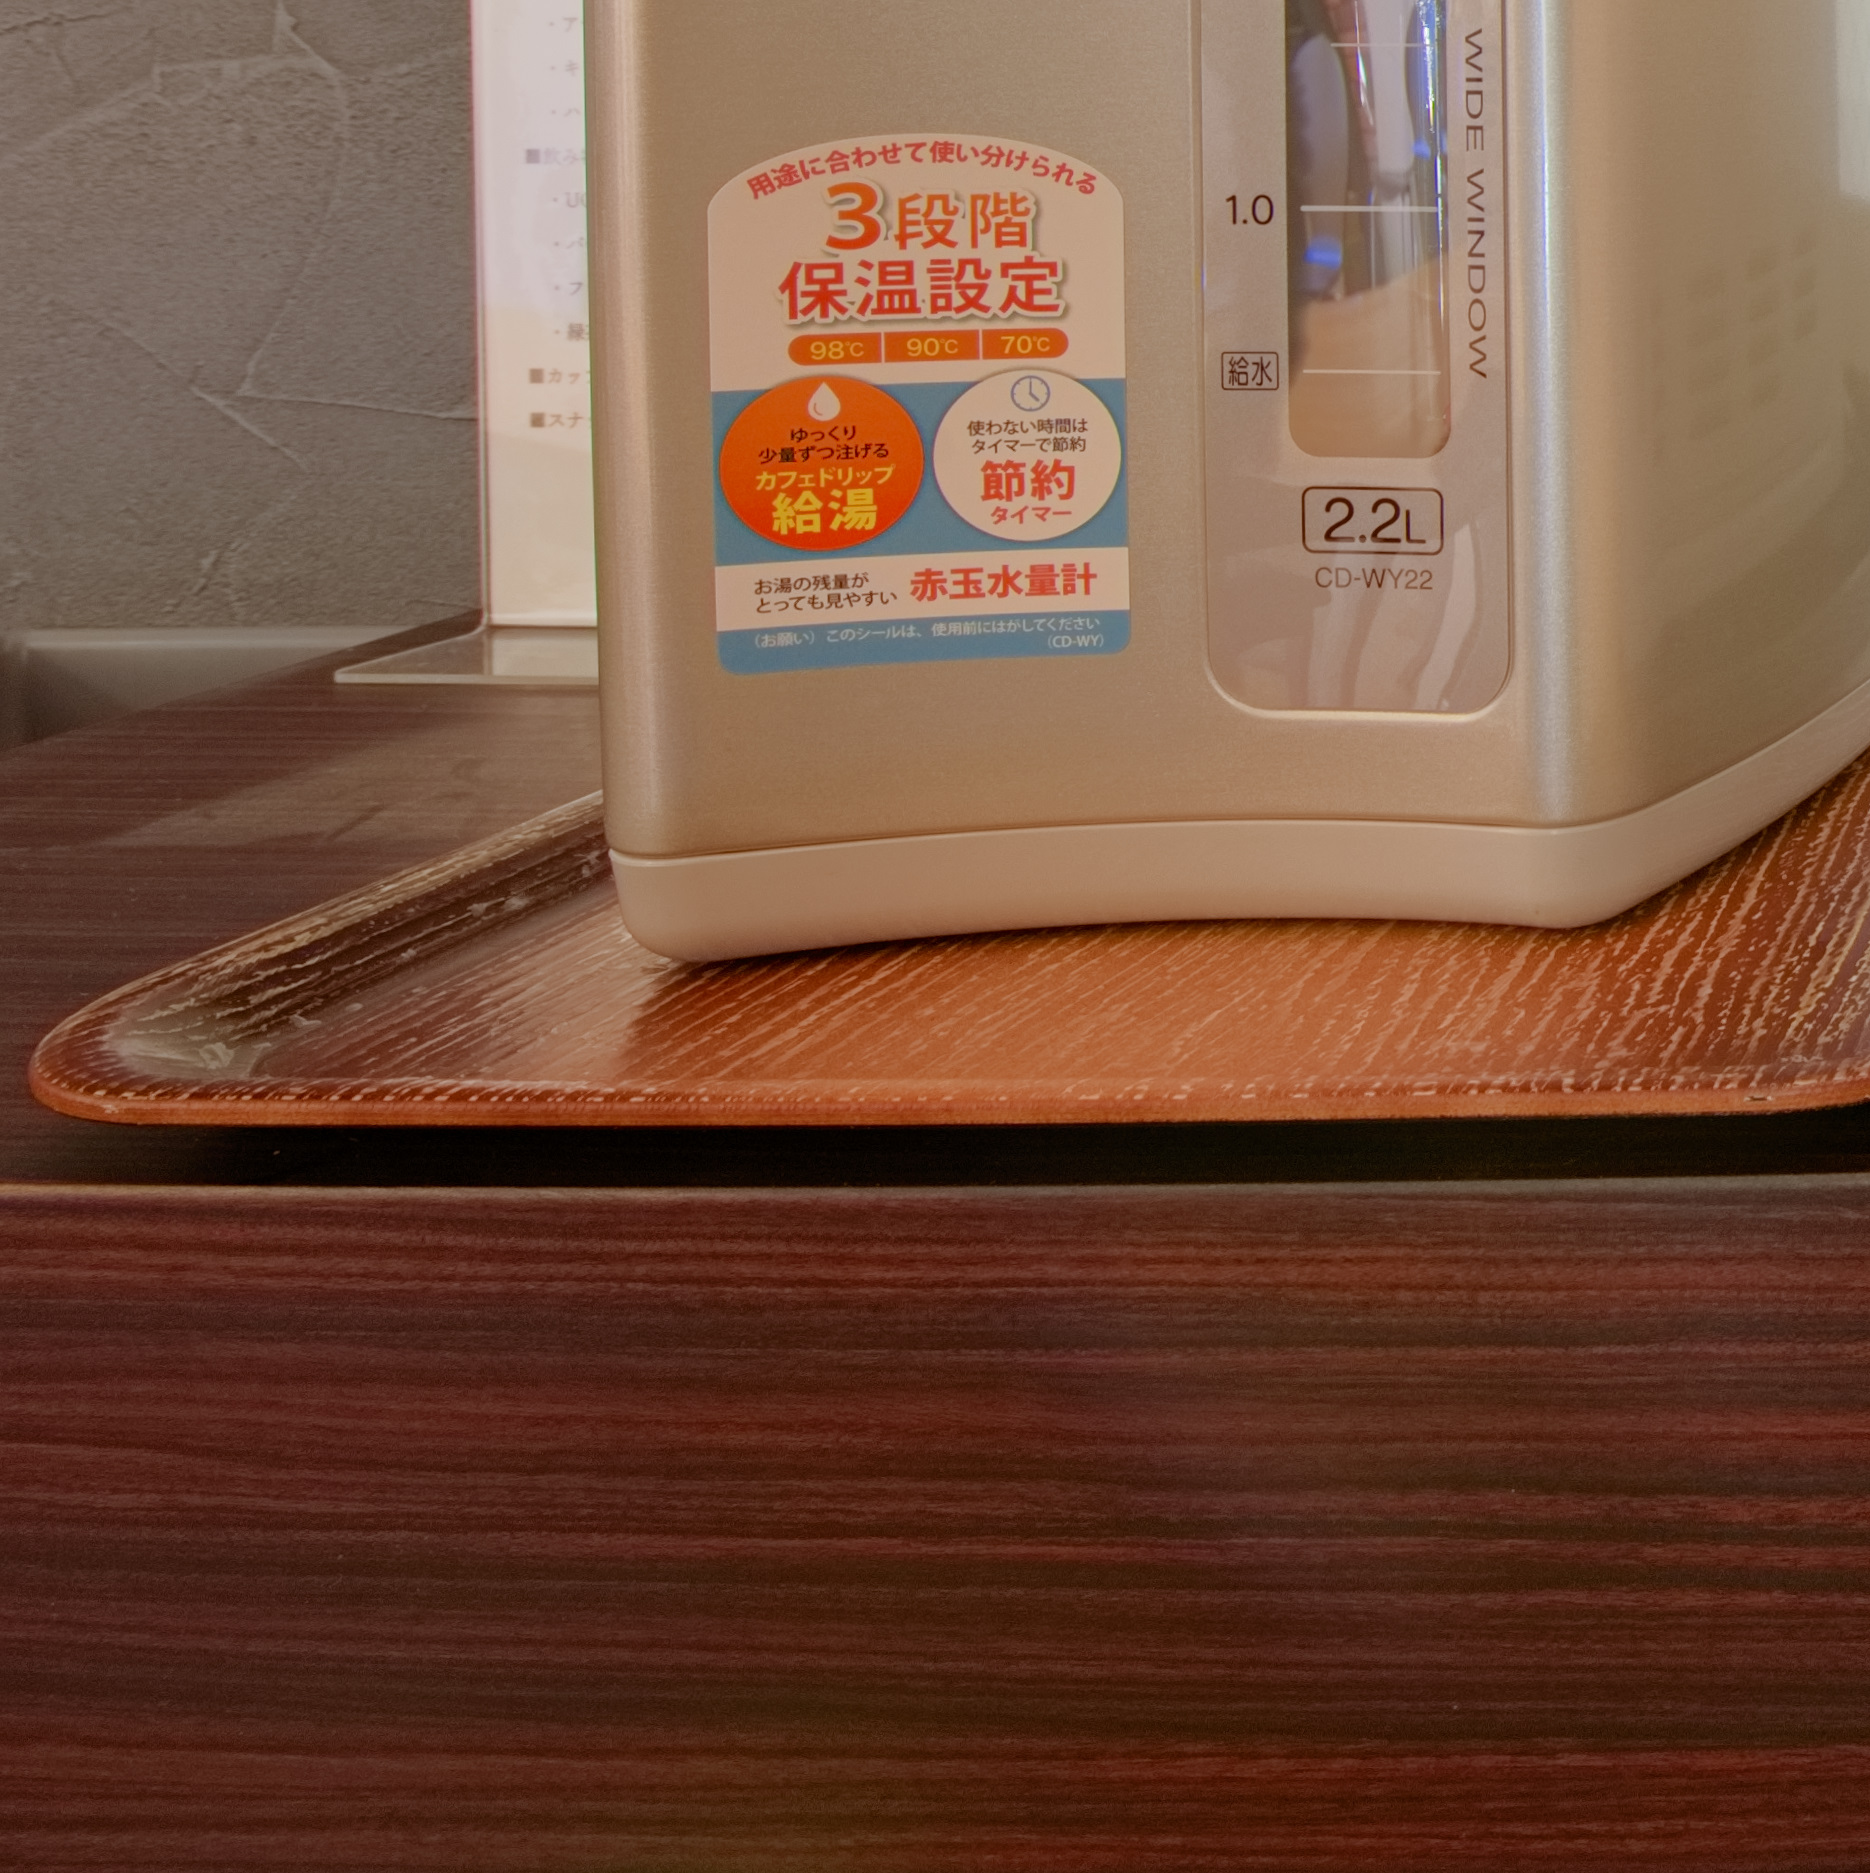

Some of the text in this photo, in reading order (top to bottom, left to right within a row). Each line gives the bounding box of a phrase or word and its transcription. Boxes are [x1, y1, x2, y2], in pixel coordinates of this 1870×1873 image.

[746, 140, 1098, 200] 用途に合わせて使い分けられる
[825, 182, 1032, 251] 3段階
[1226, 194, 1275, 225] 1.0
[1465, 28, 1488, 379] WIDE WINDOW
[778, 256, 1062, 321] 保温設定
[1228, 355, 1273, 386] 給水
[790, 425, 857, 442] ゆっくり
[966, 418, 1088, 437] 使わない時間は
[758, 443, 889, 464] 少量ずつ注げる
[971, 436, 1087, 454] タイマーで節約
[755, 464, 896, 491] カフェドリップ
[980, 459, 1076, 502] 節約
[772, 488, 878, 535] 給湯
[990, 506, 1073, 526] タイマー
[1324, 497, 1427, 544] 2.2L
[754, 572, 869, 595] お湯の残量が
[909, 562, 1098, 603] 赤玉水量計
[1315, 566, 1433, 590] CD-WY22
[755, 590, 898, 614] とっても見やすい
